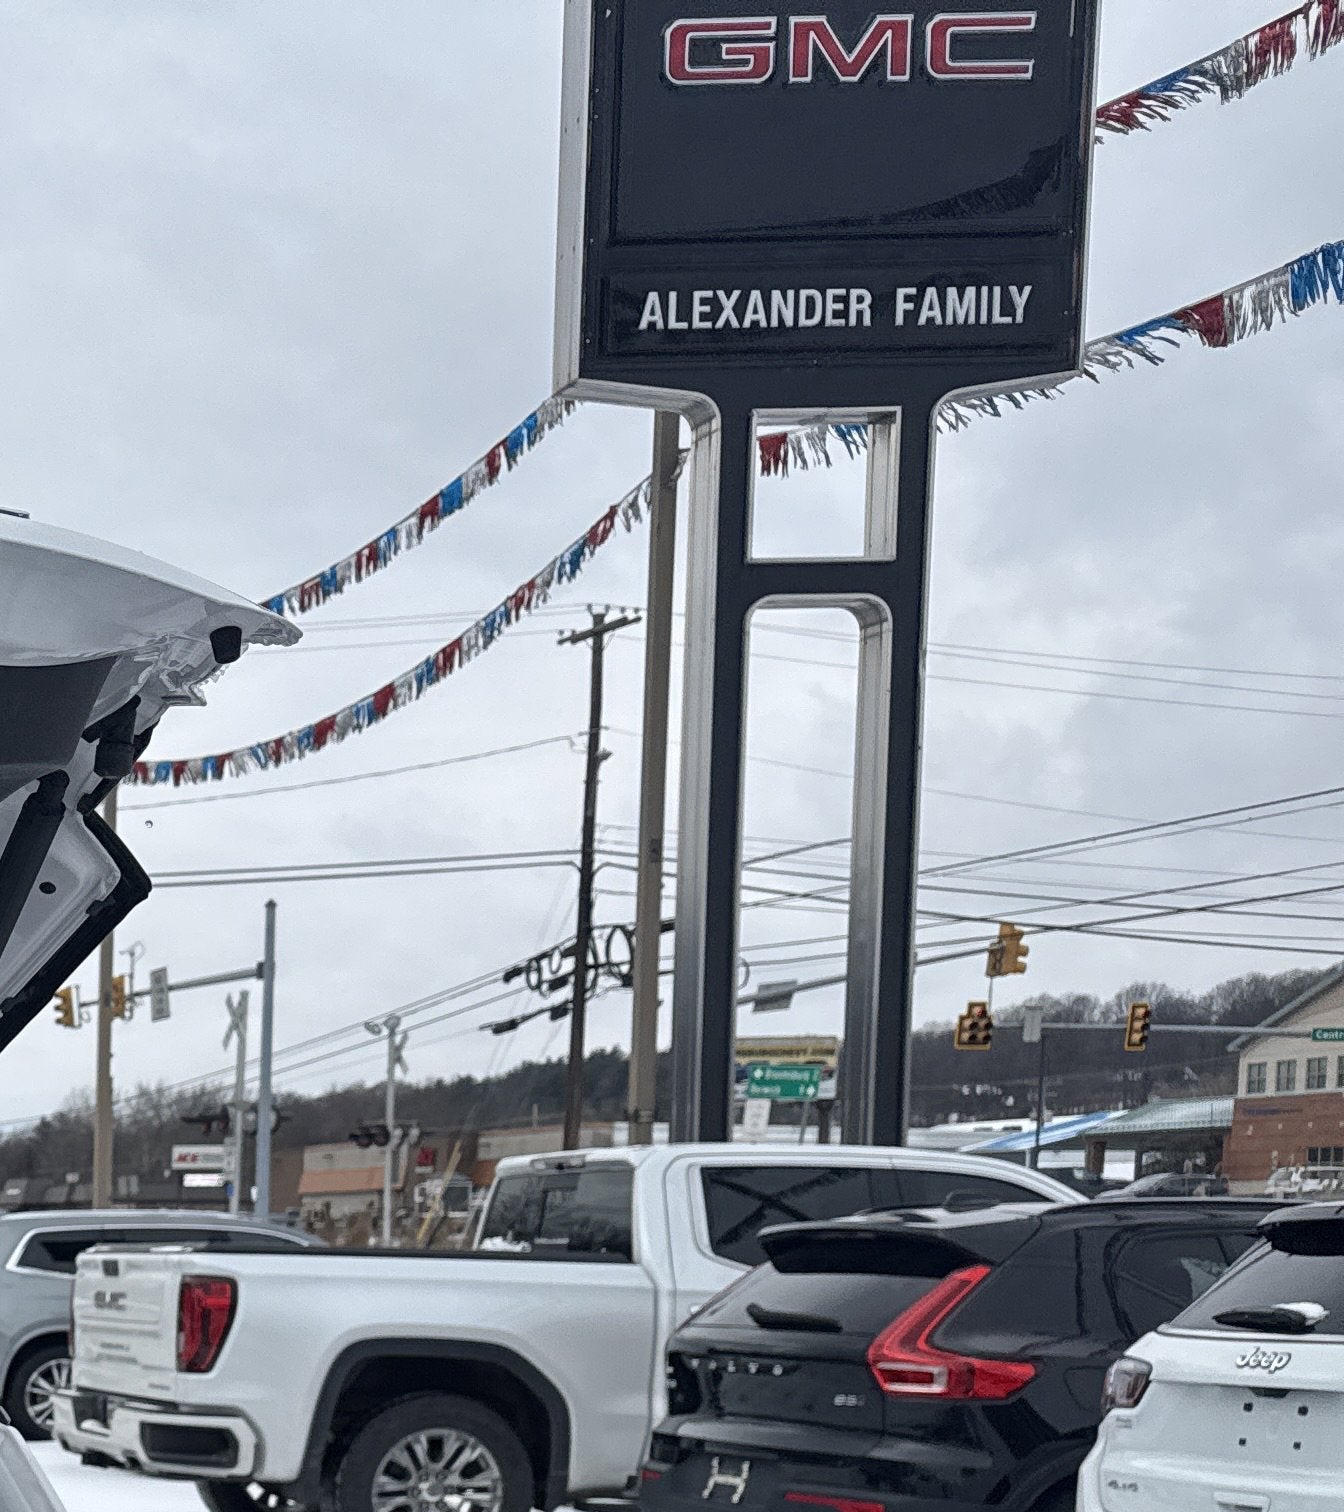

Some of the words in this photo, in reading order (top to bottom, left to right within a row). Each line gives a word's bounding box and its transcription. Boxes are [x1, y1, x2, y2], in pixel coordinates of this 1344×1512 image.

[665, 11, 1037, 84] GMC
[638, 288, 872, 330] ALEXANDER
[895, 285, 1032, 326] FAMILY
[691, 1358, 783, 1377] VOLVO
[1235, 1346, 1291, 1374] Jeep
